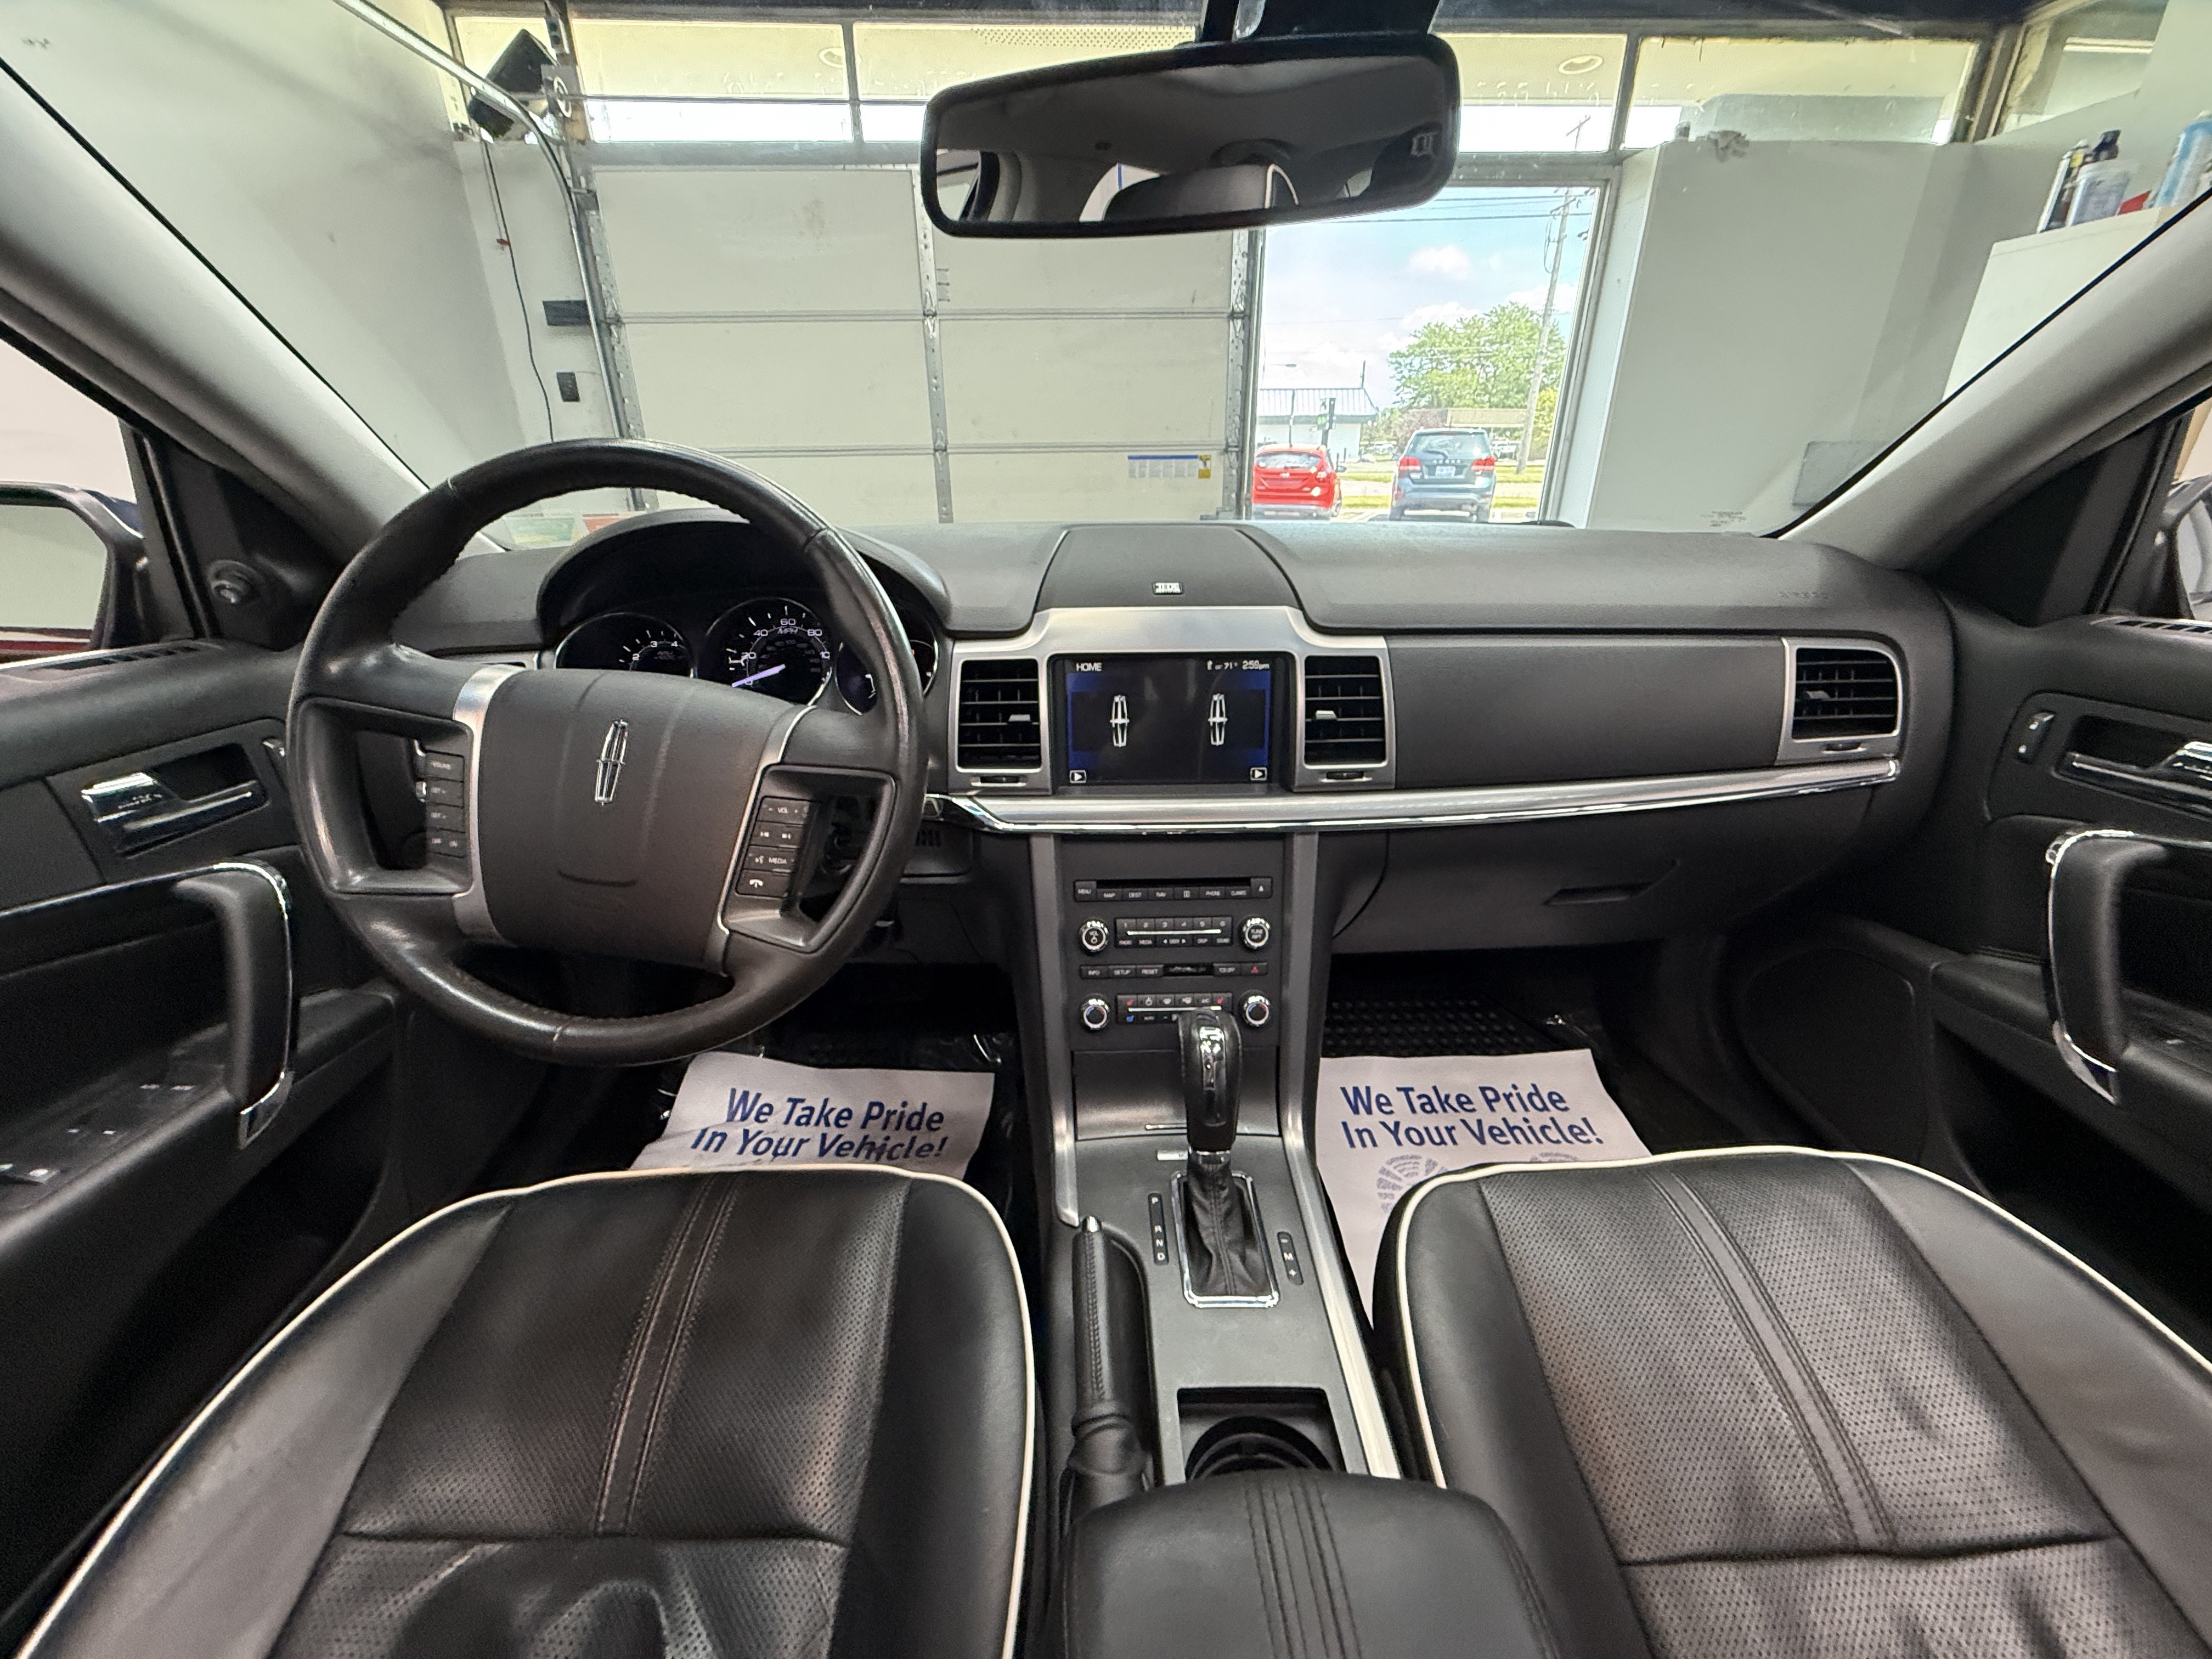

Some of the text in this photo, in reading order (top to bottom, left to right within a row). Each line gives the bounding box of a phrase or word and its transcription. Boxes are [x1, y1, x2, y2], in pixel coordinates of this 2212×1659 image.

[632, 653, 640, 661] 2
[1076, 662, 1102, 672] HOME
[726, 1088, 945, 1132] We Take Pride
[1340, 1084, 1570, 1115] We Take Pride
[690, 1127, 948, 1161] In Your Vehicle!
[1341, 1117, 1604, 1149] In Your Vehicle!
[1284, 1252, 1294, 1261] M
